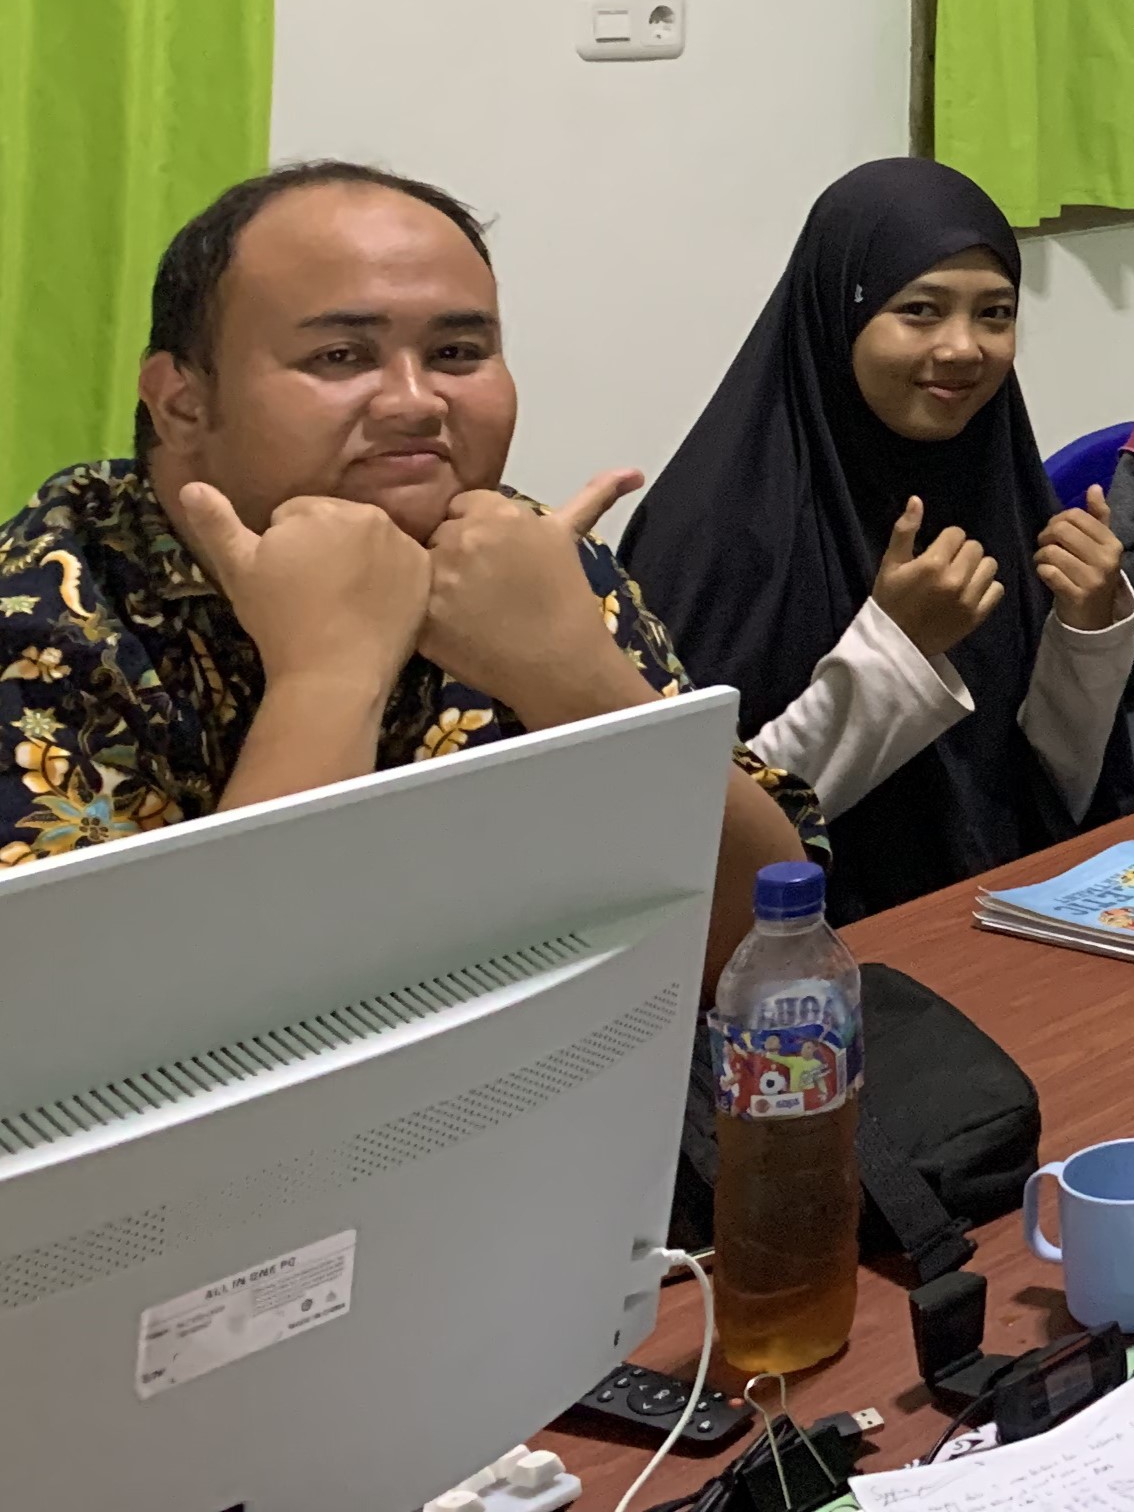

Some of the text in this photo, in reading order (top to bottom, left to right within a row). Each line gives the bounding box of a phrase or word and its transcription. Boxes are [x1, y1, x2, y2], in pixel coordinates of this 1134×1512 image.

[205, 1256, 297, 1300] ALL IN ONE PC
